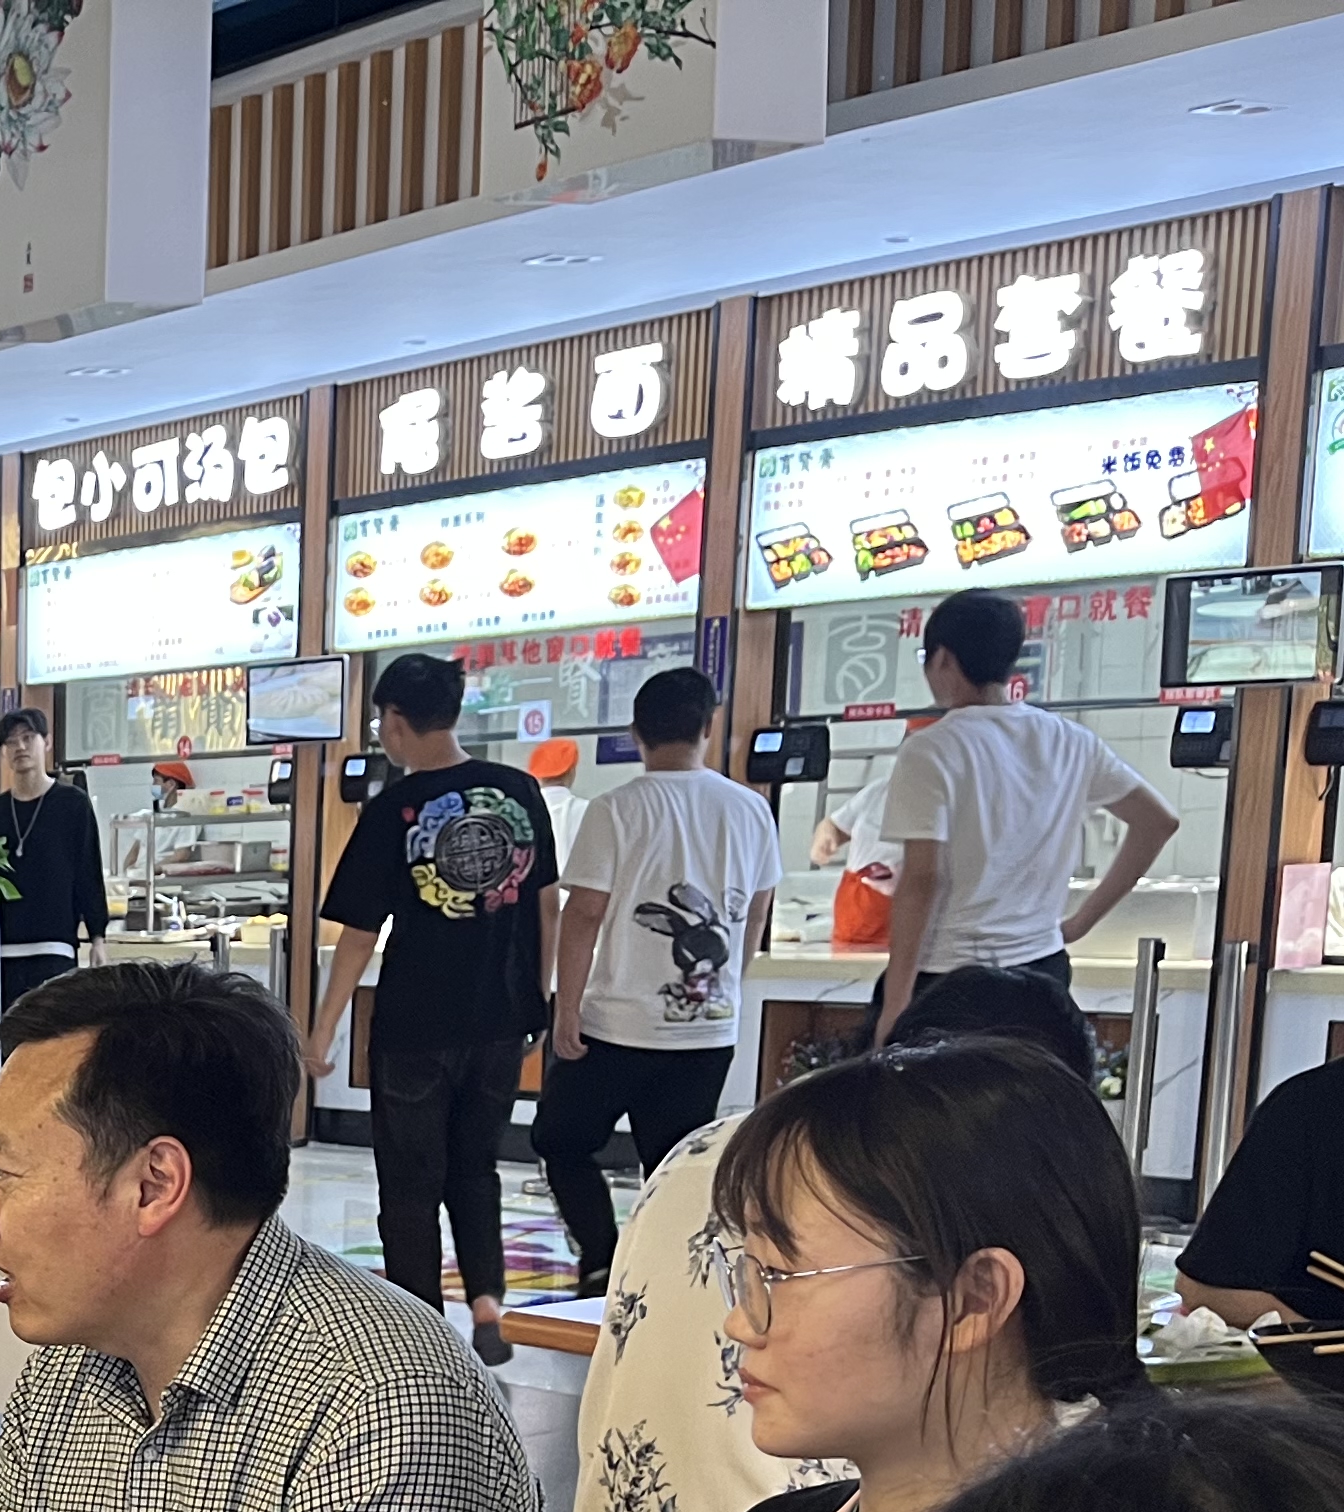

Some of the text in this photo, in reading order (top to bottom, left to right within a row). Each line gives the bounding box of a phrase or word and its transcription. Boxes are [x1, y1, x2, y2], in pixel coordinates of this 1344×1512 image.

[776, 248, 1205, 410] 精品套餐
[32, 415, 290, 531] 包小可汤包
[1101, 445, 1195, 475] 米饭免费
[526, 711, 544, 734] 15
